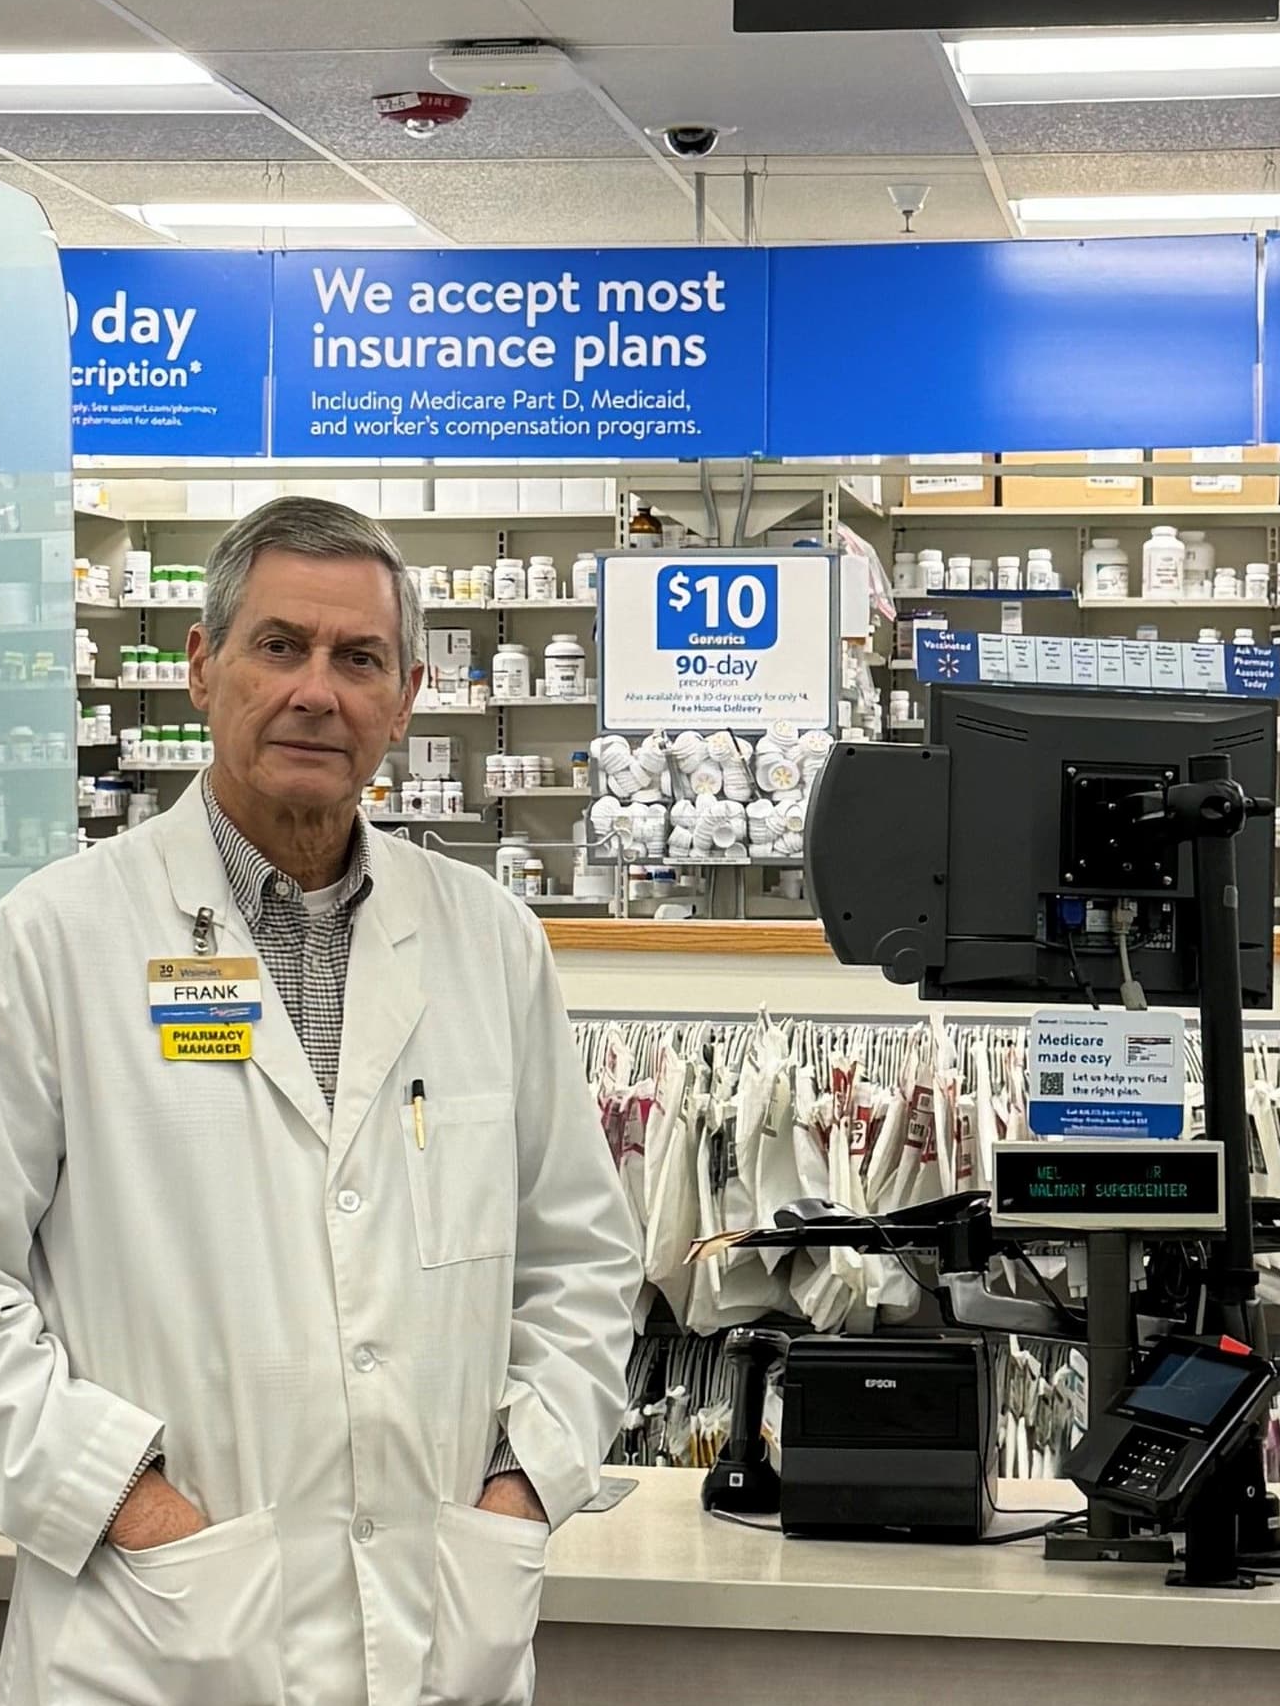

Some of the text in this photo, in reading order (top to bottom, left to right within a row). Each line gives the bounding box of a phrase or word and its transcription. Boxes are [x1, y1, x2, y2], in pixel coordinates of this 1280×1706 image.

[312, 267, 726, 328] We accept most
[91, 289, 199, 362] day
[312, 321, 707, 381] insurance plans
[311, 389, 692, 416] Including Medicare Part D, Medicaid,
[310, 414, 703, 441] and worker's compensation programs.
[668, 570, 767, 630] $10
[688, 632, 746, 646] Generics
[675, 654, 758, 681] 90-day
[678, 677, 739, 690] prescription
[159, 964, 174, 974] 30
[174, 985, 239, 1001] FRANK
[173, 1030, 245, 1042] PHARMACY
[1037, 1032, 1104, 1047] Medicare
[177, 1043, 241, 1054] MANAGER
[1037, 1050, 1112, 1067] made easy
[1072, 1073, 1088, 1082] Let
[1103, 1073, 1125, 1085] help
[1127, 1076, 1145, 1085] you
[1147, 1074, 1168, 1083] find
[1072, 1086, 1142, 1097] the right plan.
[1029, 1183, 1188, 1198] WALMART SUPERCENTER
[865, 1378, 897, 1389] EPSON
